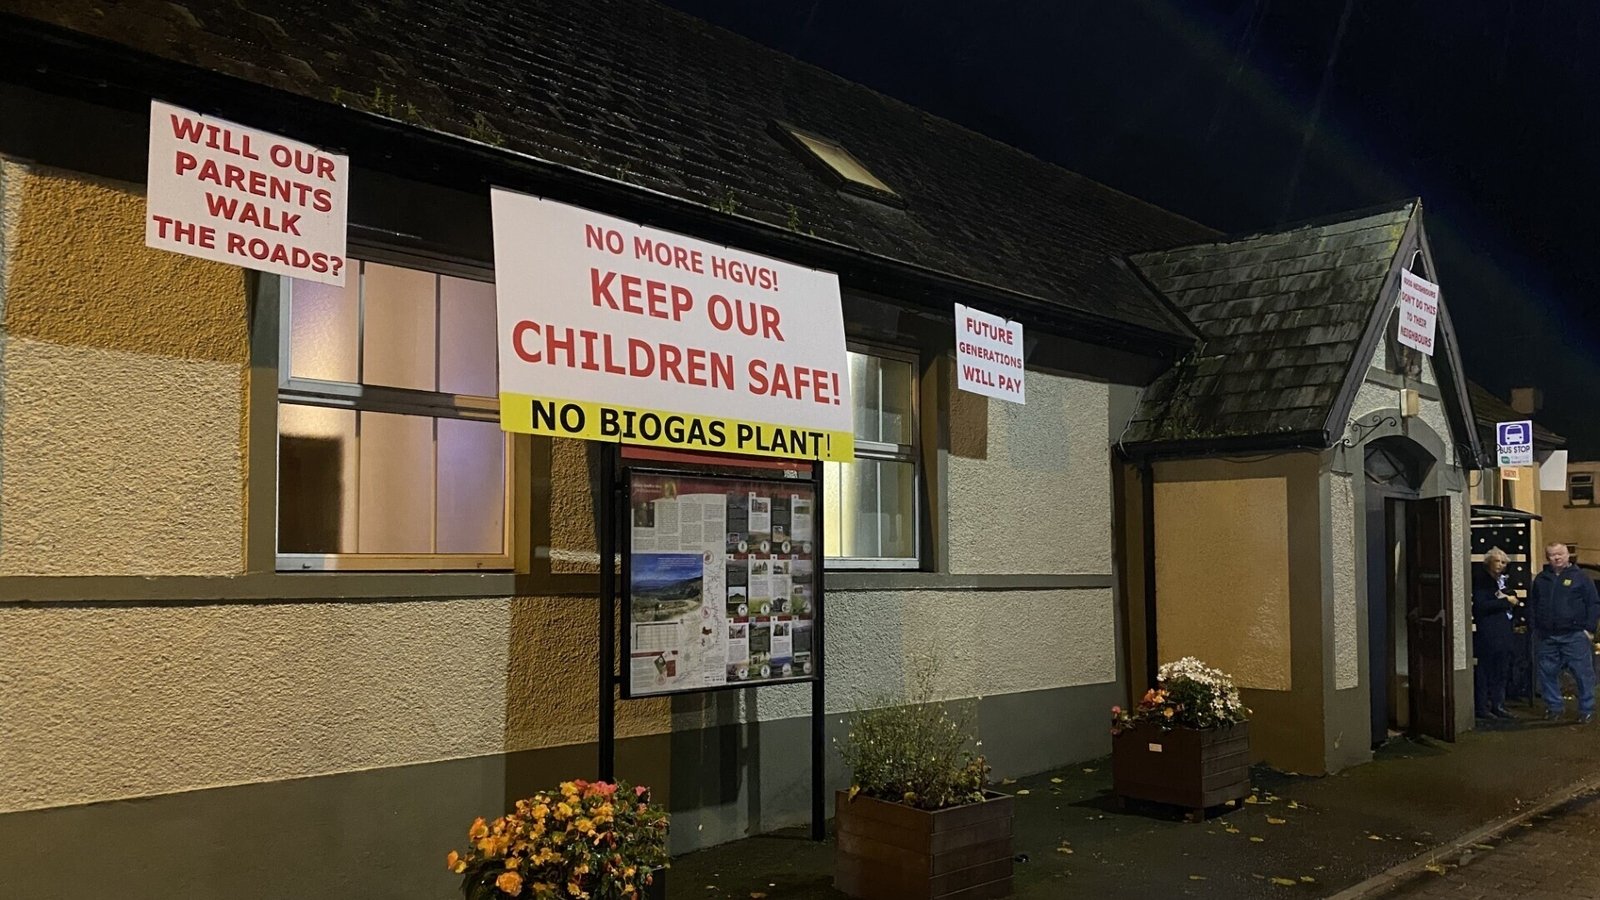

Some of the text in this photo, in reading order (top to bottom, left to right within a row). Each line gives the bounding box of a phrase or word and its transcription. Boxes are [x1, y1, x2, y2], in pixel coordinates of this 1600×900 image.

[171, 114, 336, 182] WILL OUR
[175, 151, 331, 212] PARENTS
[205, 192, 301, 236] WALK
[153, 215, 343, 276] THE ROADS?
[585, 224, 778, 292] NO MORE HGVS!
[590, 268, 785, 342] KEEP OUR
[1402, 292, 1437, 315] DON'T DO THIS
[1406, 312, 1427, 327] TO THEIR
[967, 318, 1013, 345] FUTURE
[1400, 326, 1432, 348] NEIGHBOURS
[512, 320, 841, 405] CHILDREN SAFE!
[959, 342, 1022, 369] GENERATIONS
[963, 364, 1022, 394] WILL PAY
[531, 400, 832, 458] NO BIOGAS PLANT!
[1500, 445, 1530, 454] BUS STOP
